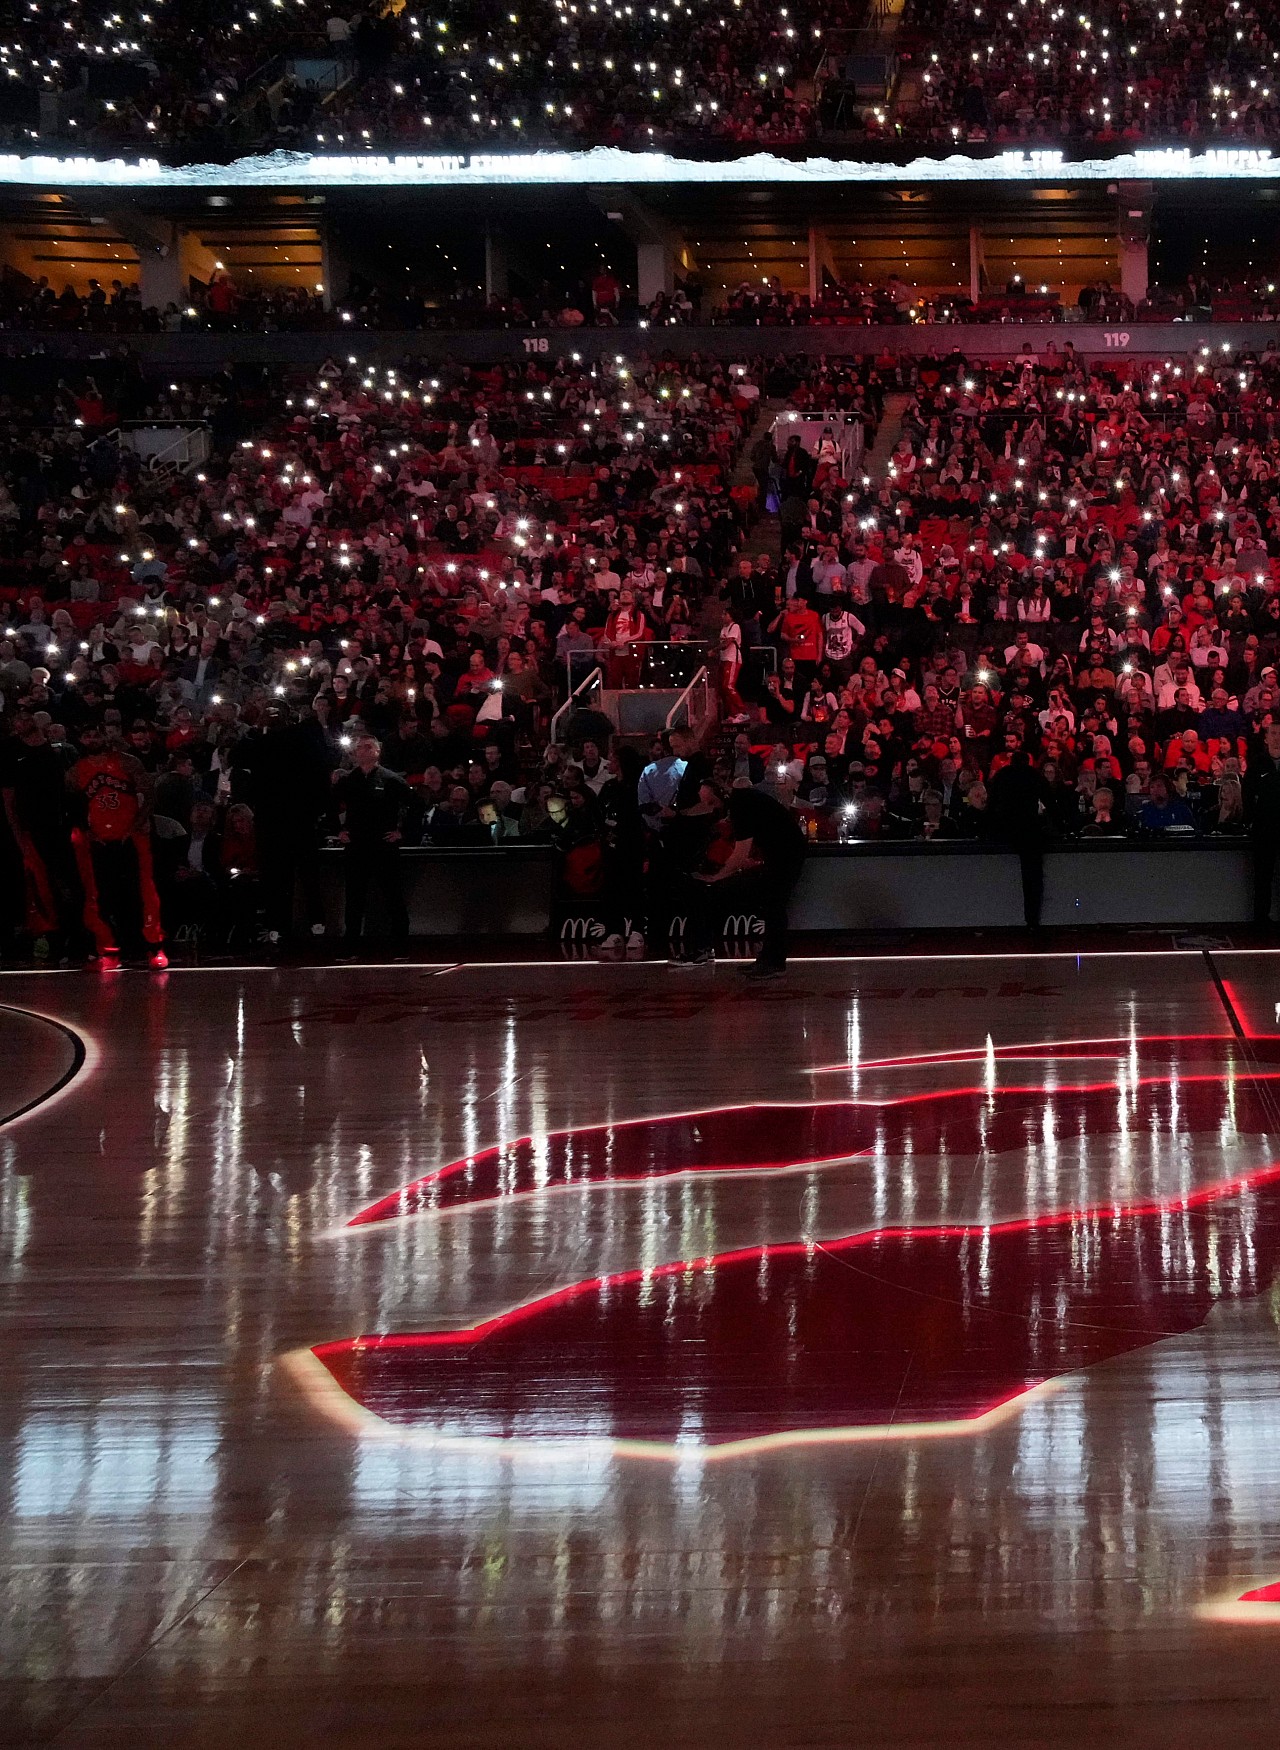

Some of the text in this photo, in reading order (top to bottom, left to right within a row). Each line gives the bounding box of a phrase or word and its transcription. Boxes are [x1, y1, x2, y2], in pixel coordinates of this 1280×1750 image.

[522, 338, 549, 352] 118
[1103, 332, 1130, 347] 119
[96, 791, 121, 810] 33
